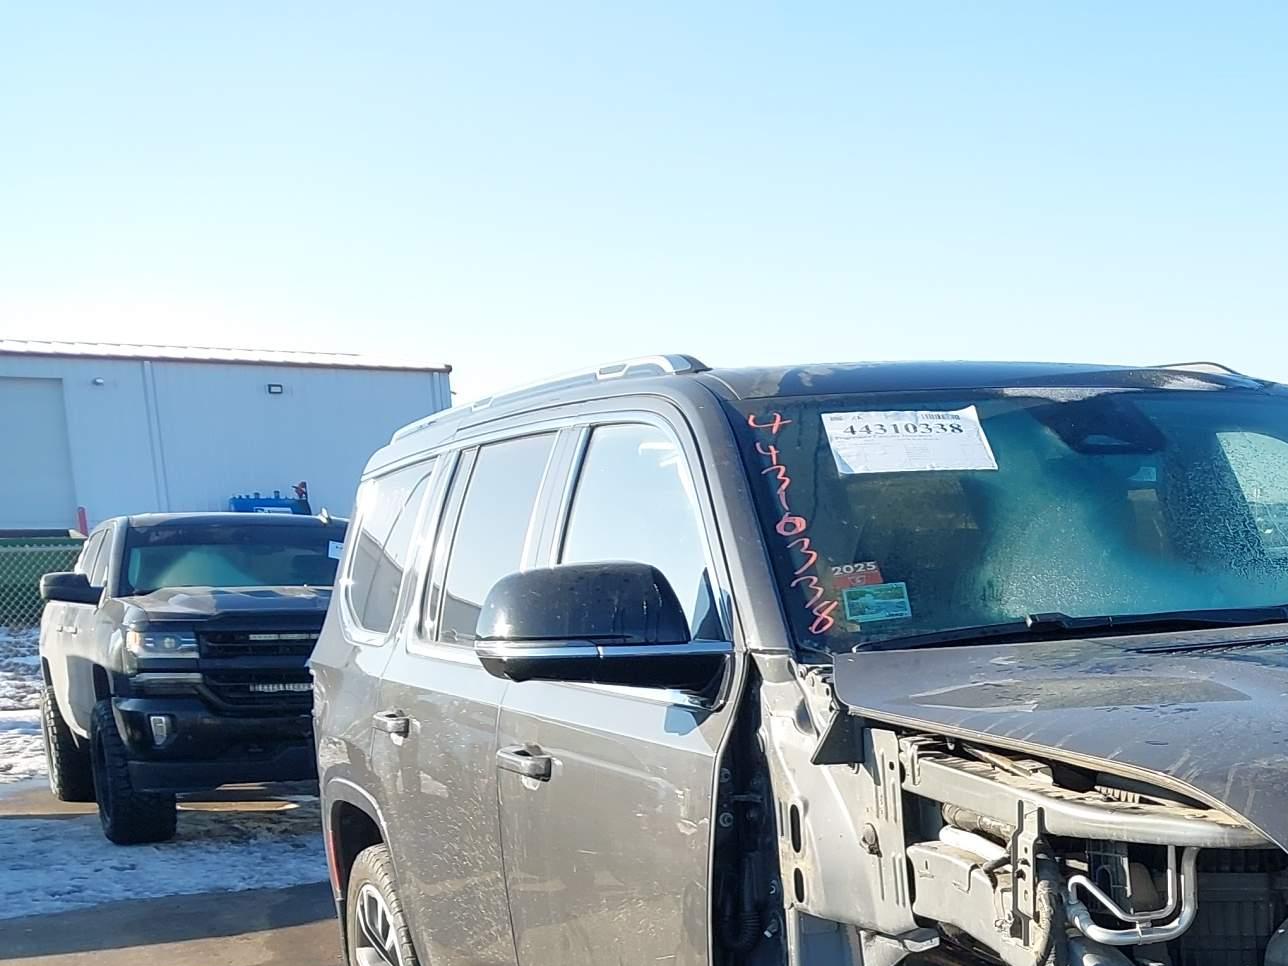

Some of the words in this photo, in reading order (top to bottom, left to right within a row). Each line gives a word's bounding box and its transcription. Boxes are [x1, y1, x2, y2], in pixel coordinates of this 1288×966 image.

[843, 423, 964, 435] 44310338
[749, 413, 838, 634] 44310338
[832, 562, 877, 576] 2025
